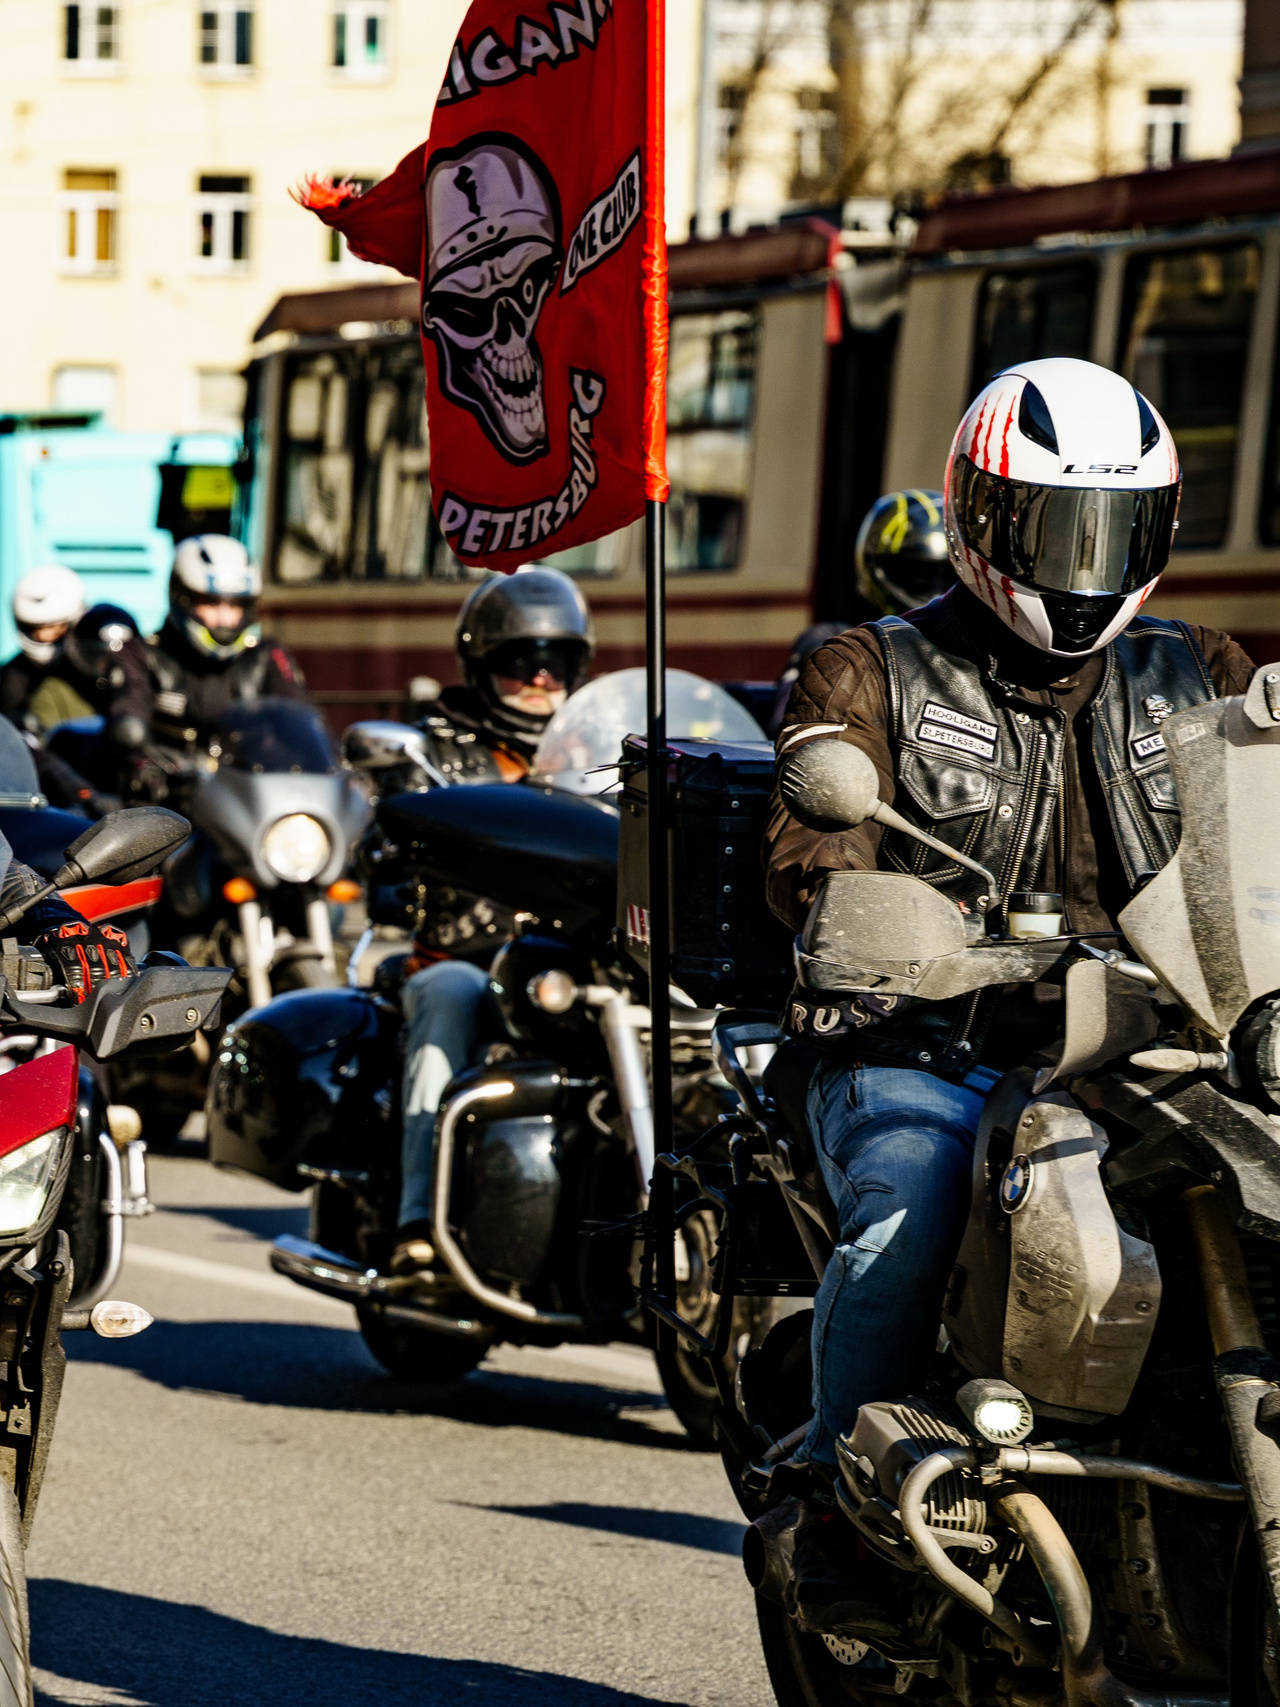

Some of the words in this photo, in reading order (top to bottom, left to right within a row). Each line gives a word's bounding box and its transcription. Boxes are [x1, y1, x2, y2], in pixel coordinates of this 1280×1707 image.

[437, 0, 612, 100] IGAN
[600, 171, 637, 246] CLUB
[439, 373, 604, 553] PETERSBURG
[1062, 464, 1139, 475] LS2
[927, 707, 993, 736] HOOLIGANS
